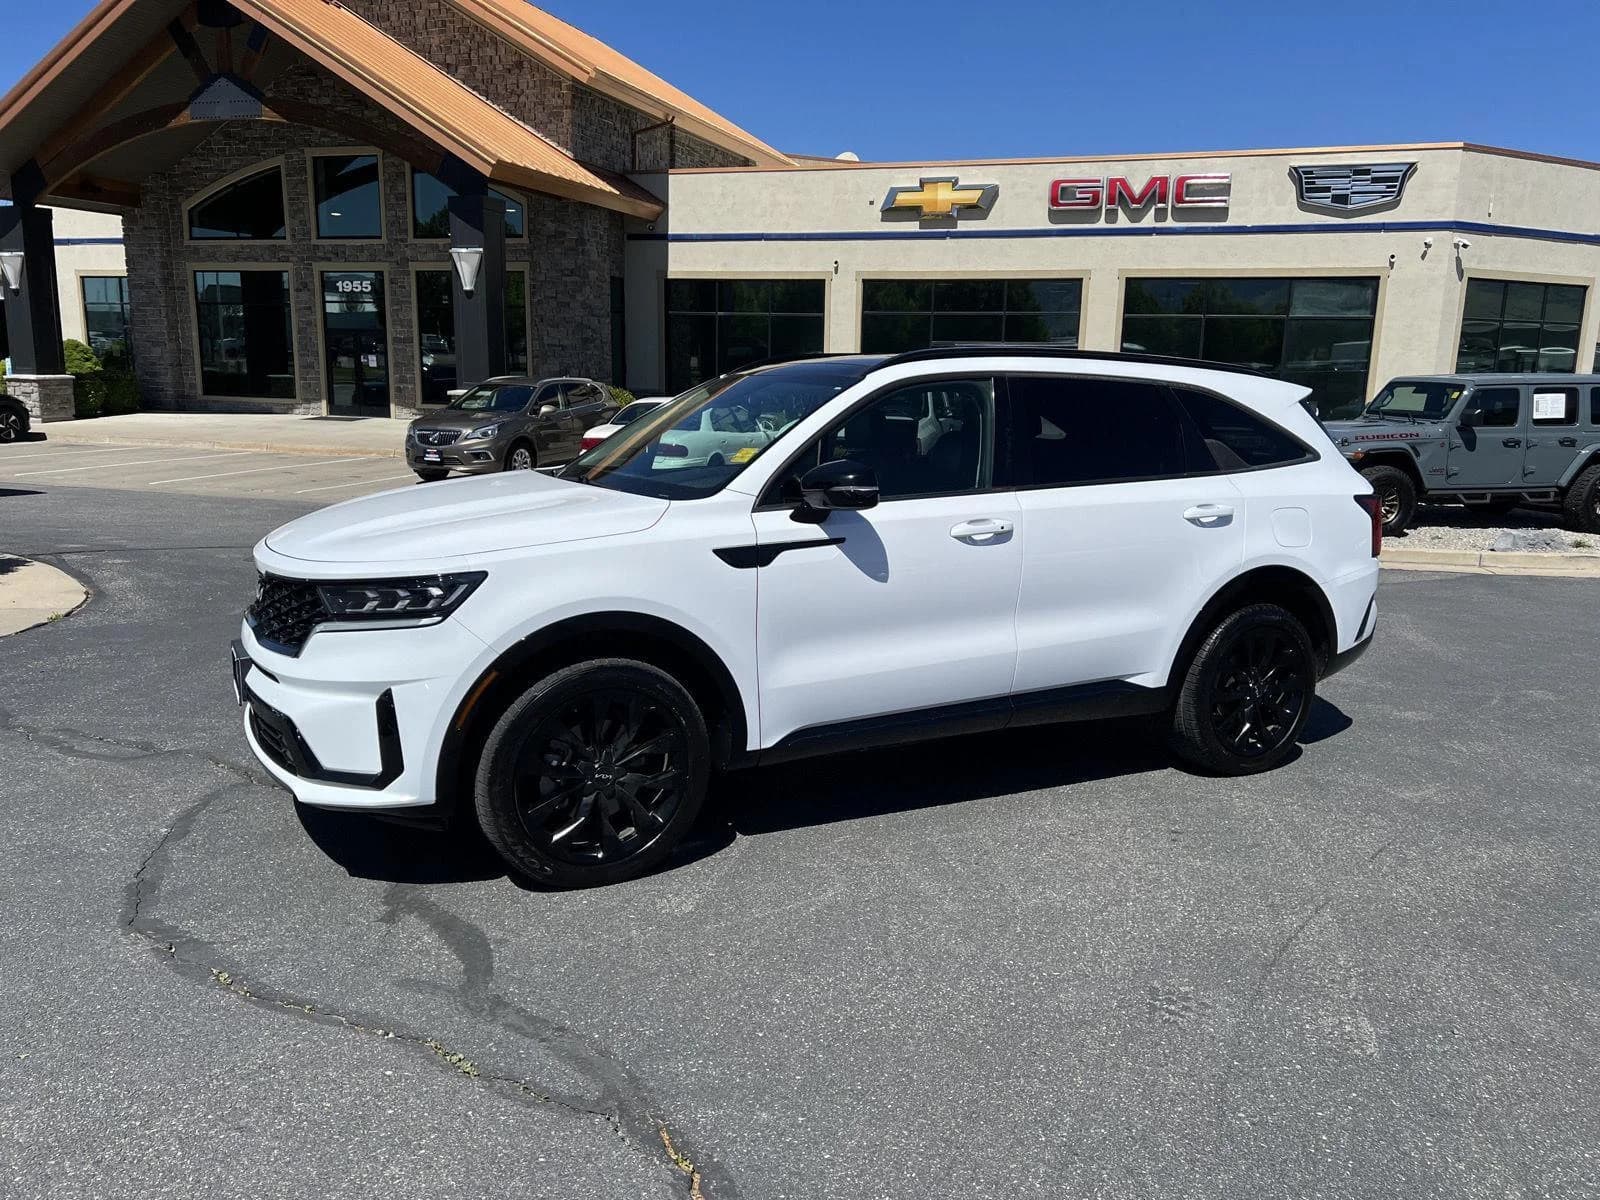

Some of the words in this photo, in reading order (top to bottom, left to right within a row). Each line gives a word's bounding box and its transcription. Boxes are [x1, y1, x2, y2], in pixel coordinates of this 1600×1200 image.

[1049, 173, 1231, 212] GMC
[336, 280, 371, 292] 1955
[1354, 432, 1420, 441] RUBICON
